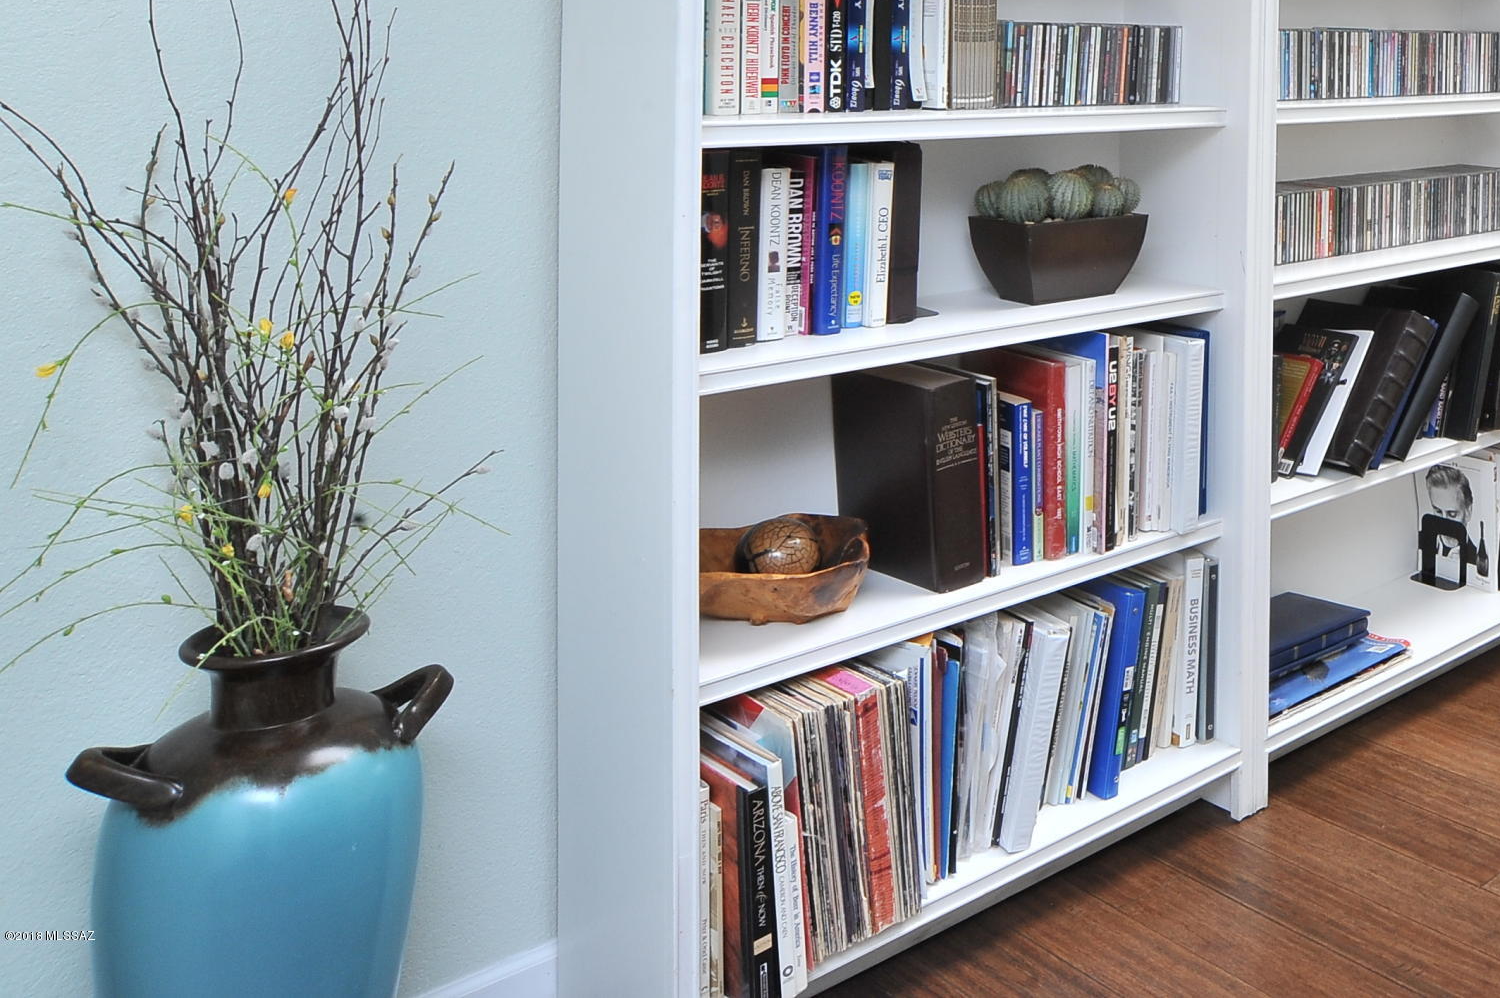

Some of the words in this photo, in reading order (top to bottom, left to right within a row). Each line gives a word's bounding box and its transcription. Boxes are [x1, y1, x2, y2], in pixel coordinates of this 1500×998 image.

[746, 2, 760, 23] DEAN
[781, 5, 790, 36] CONCERT
[809, 2, 818, 36] BENNY
[832, 10, 841, 28] T-120
[746, 25, 759, 55] KOONTZ
[809, 41, 818, 64] HILL
[720, 35, 735, 94] CRICHTON
[781, 46, 791, 66] FLOYD
[745, 58, 759, 98] HIDEAWAY
[781, 68, 791, 85] PINK
[830, 59, 842, 98] TDK
[770, 172, 782, 201] DEAN
[787, 178, 804, 208] DAN
[830, 162, 847, 221] KOONTZ
[769, 204, 781, 245] KOONTZ
[878, 207, 889, 233] CEO
[738, 226, 755, 282] INFERNO
[786, 213, 803, 267] BROWN
[831, 254, 840, 269] Life
[875, 243, 888, 284] Elizabeth
[766, 278, 774, 316] Memory
[775, 283, 783, 309] False
[790, 285, 799, 322] DECEPTION
[828, 269, 840, 317] Expectancy
[1109, 360, 1118, 383] U2
[1109, 383, 1117, 406] BY
[1108, 407, 1117, 431] U2
[936, 433, 976, 453] DICTIONARY
[1147, 604, 1155, 626] MULTI
[1186, 598, 1199, 656] BUSINESS
[1142, 632, 1150, 660] ENGINE
[1138, 664, 1146, 694] MANUAL
[1185, 659, 1196, 694] MATH
[700, 800, 709, 824] Paris
[771, 786, 783, 811] ABOVE
[752, 799, 766, 866] ARIZONA
[772, 830, 786, 874] FRANCISCO
[756, 866, 765, 890] THEN
[789, 859, 798, 883] History
[757, 904, 766, 927] NOW
